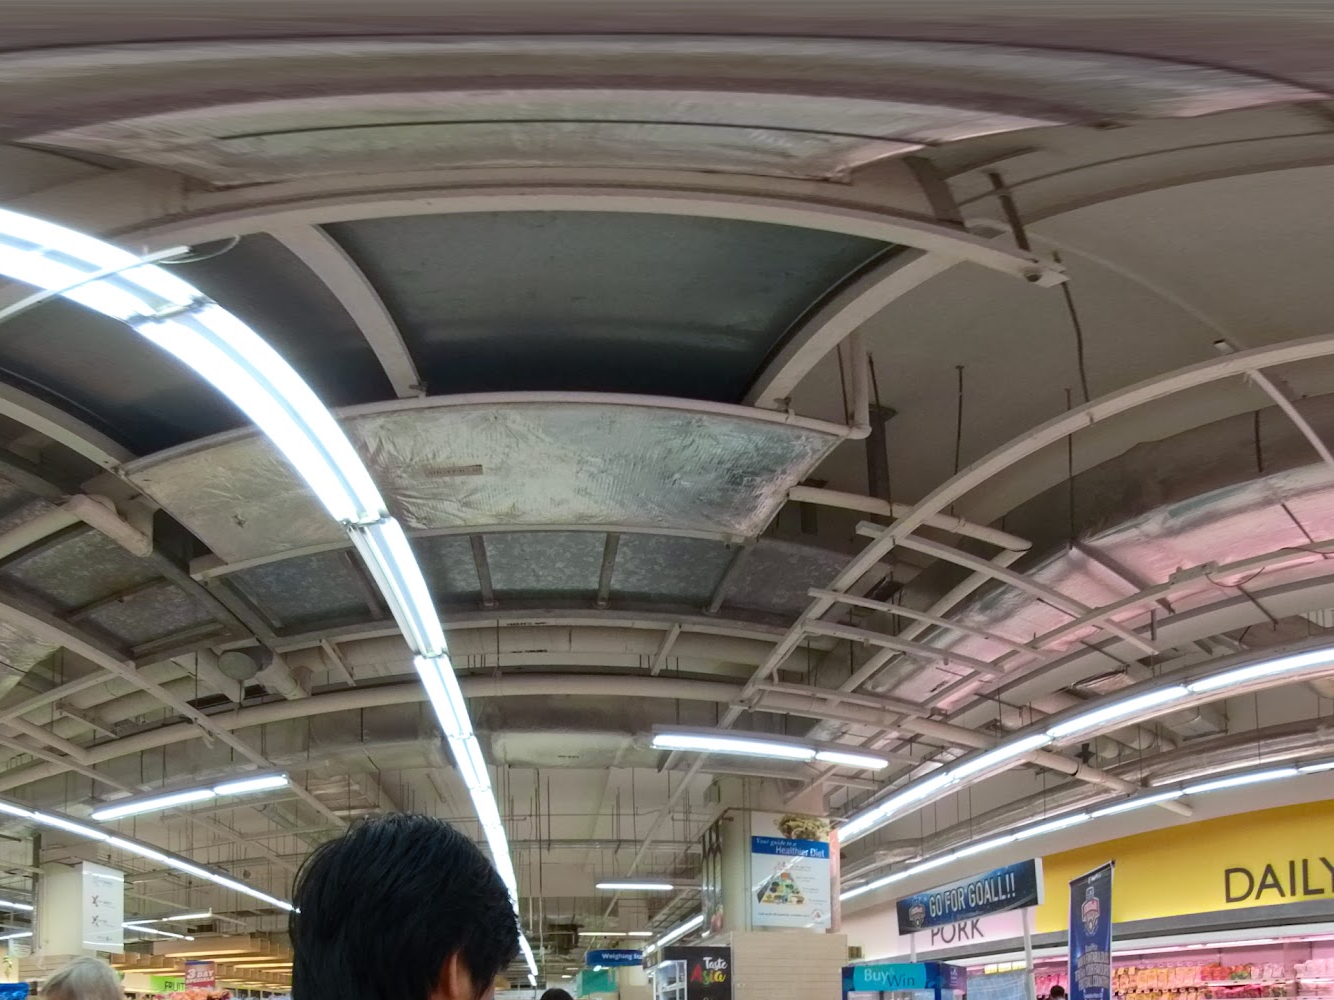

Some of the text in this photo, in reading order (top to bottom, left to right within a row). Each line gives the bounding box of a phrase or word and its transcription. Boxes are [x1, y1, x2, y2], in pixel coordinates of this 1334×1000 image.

[775, 846, 825, 857] Healthier Diet
[929, 872, 1016, 918] GO FOR GOALL!!
[931, 918, 984, 946] PORK
[703, 957, 728, 970] Taste
[690, 964, 726, 985] Asia
[864, 969, 888, 984] Buy
[887, 974, 915, 987] Win
